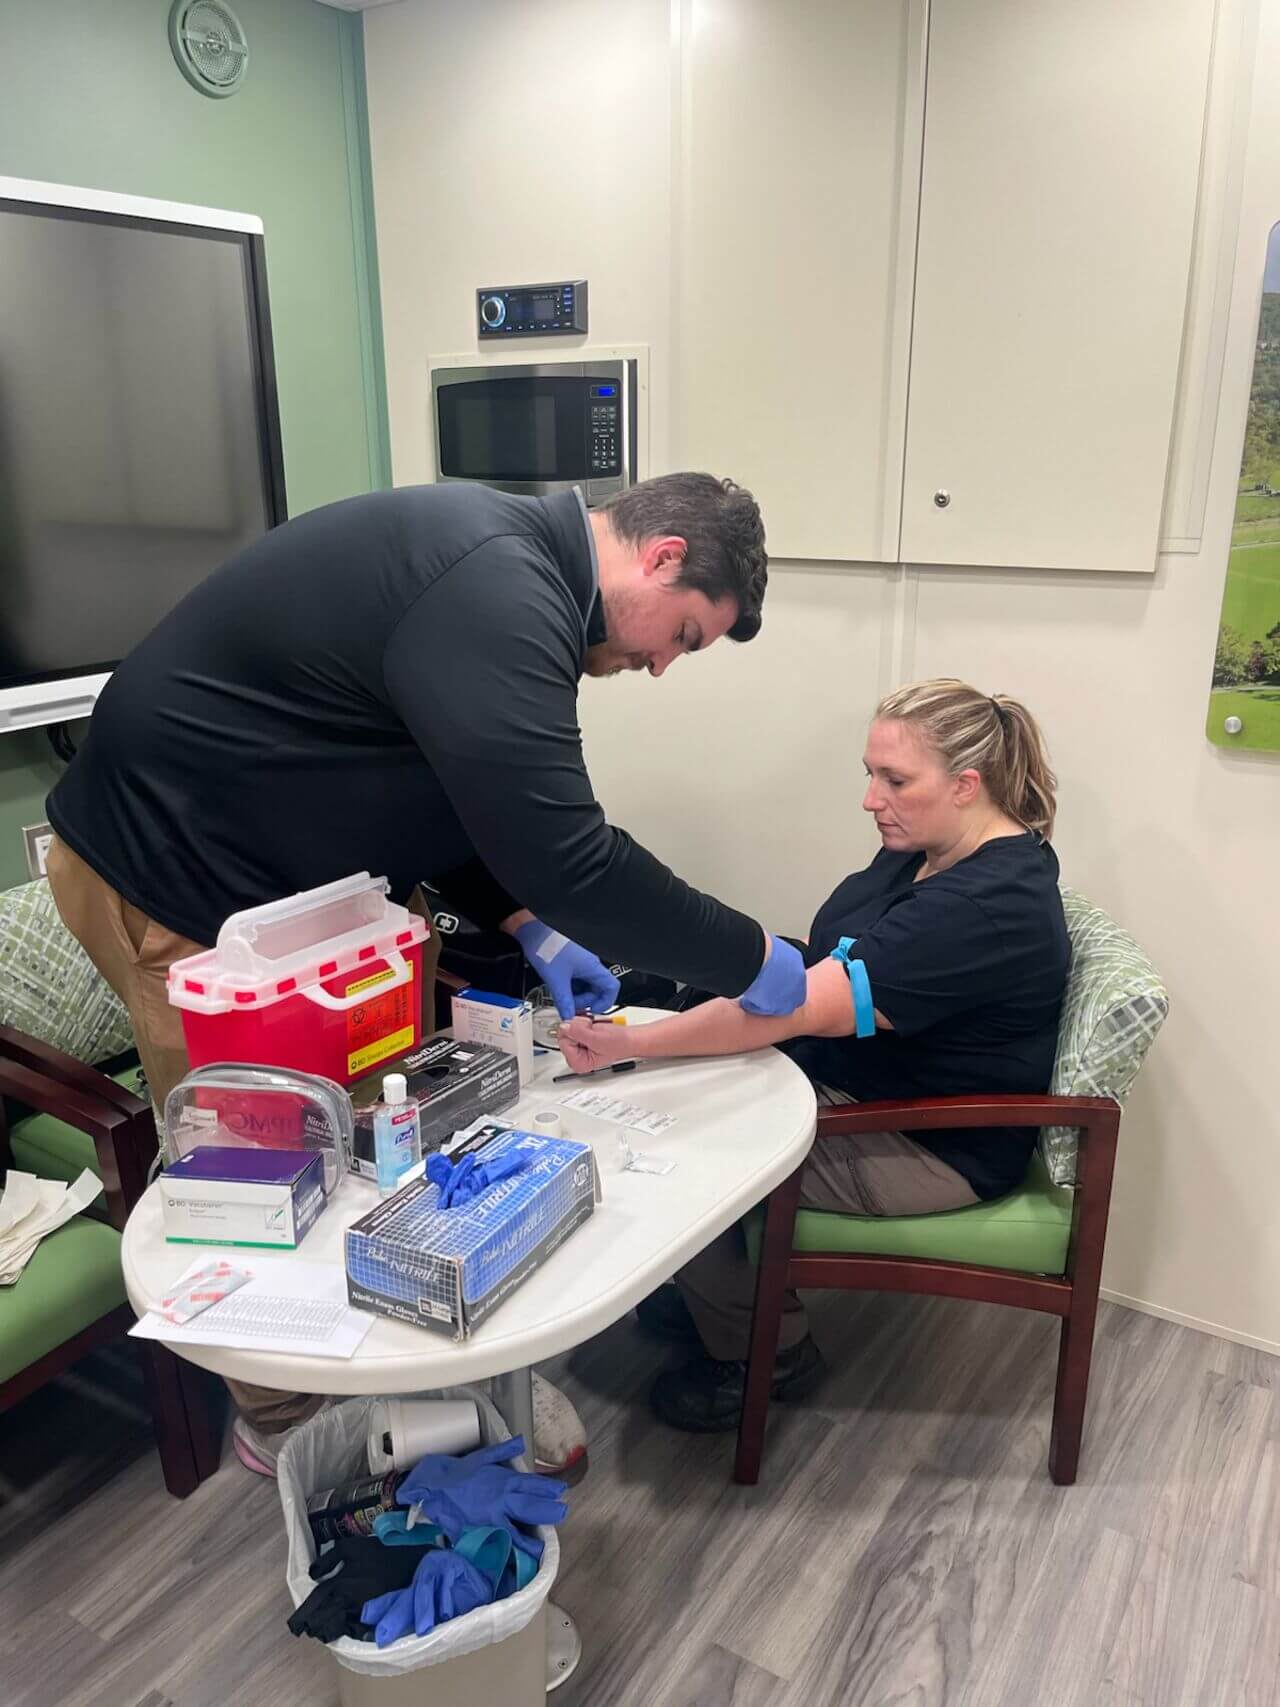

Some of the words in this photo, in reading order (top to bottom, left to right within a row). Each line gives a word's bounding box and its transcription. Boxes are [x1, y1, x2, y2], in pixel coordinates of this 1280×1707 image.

[403, 1039, 449, 1065] NitriDerm
[480, 1066, 512, 1090] NitriDerm
[389, 1260, 442, 1282] NITRILE
